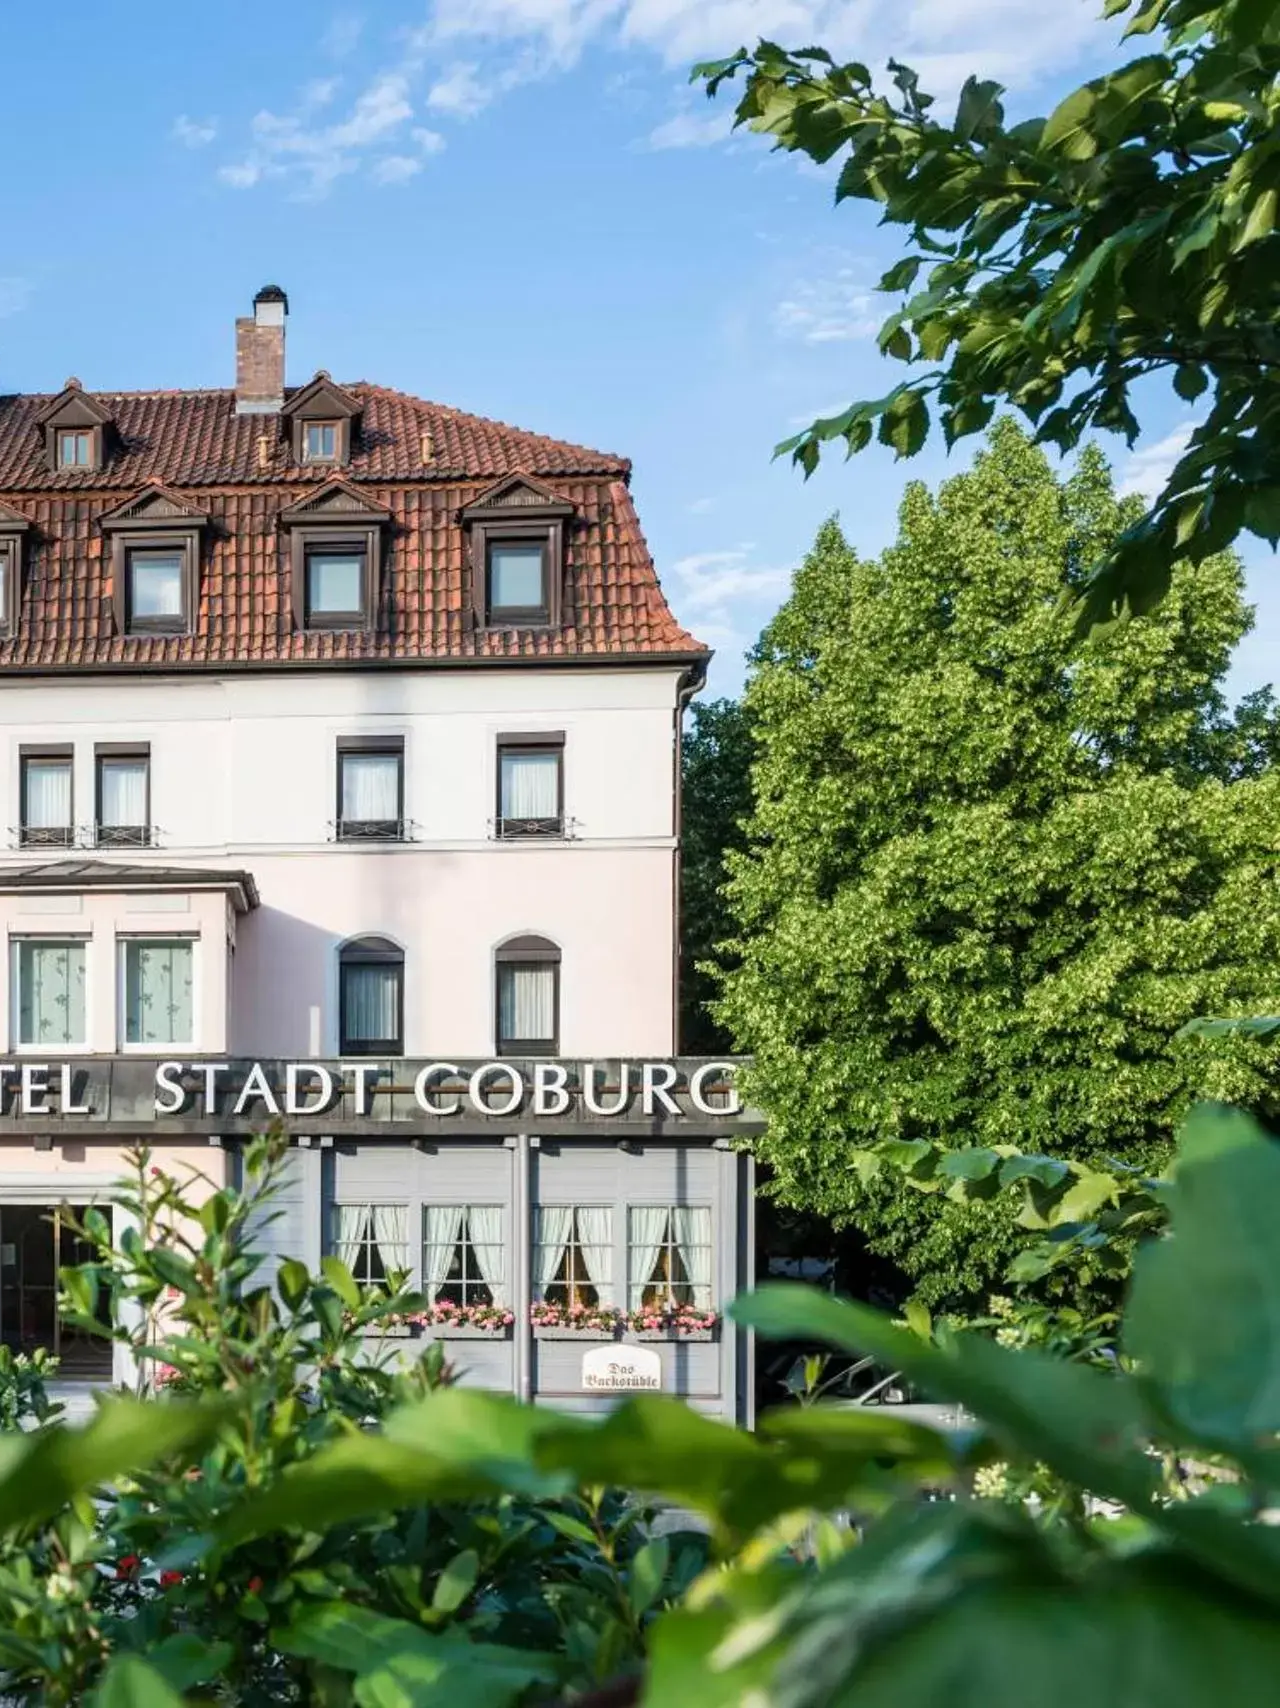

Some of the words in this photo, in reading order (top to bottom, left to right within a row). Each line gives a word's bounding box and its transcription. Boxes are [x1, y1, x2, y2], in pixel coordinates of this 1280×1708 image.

[155, 1062, 378, 1114] STADT
[414, 1062, 742, 1115] COBURG
[608, 1363, 634, 1374] Das
